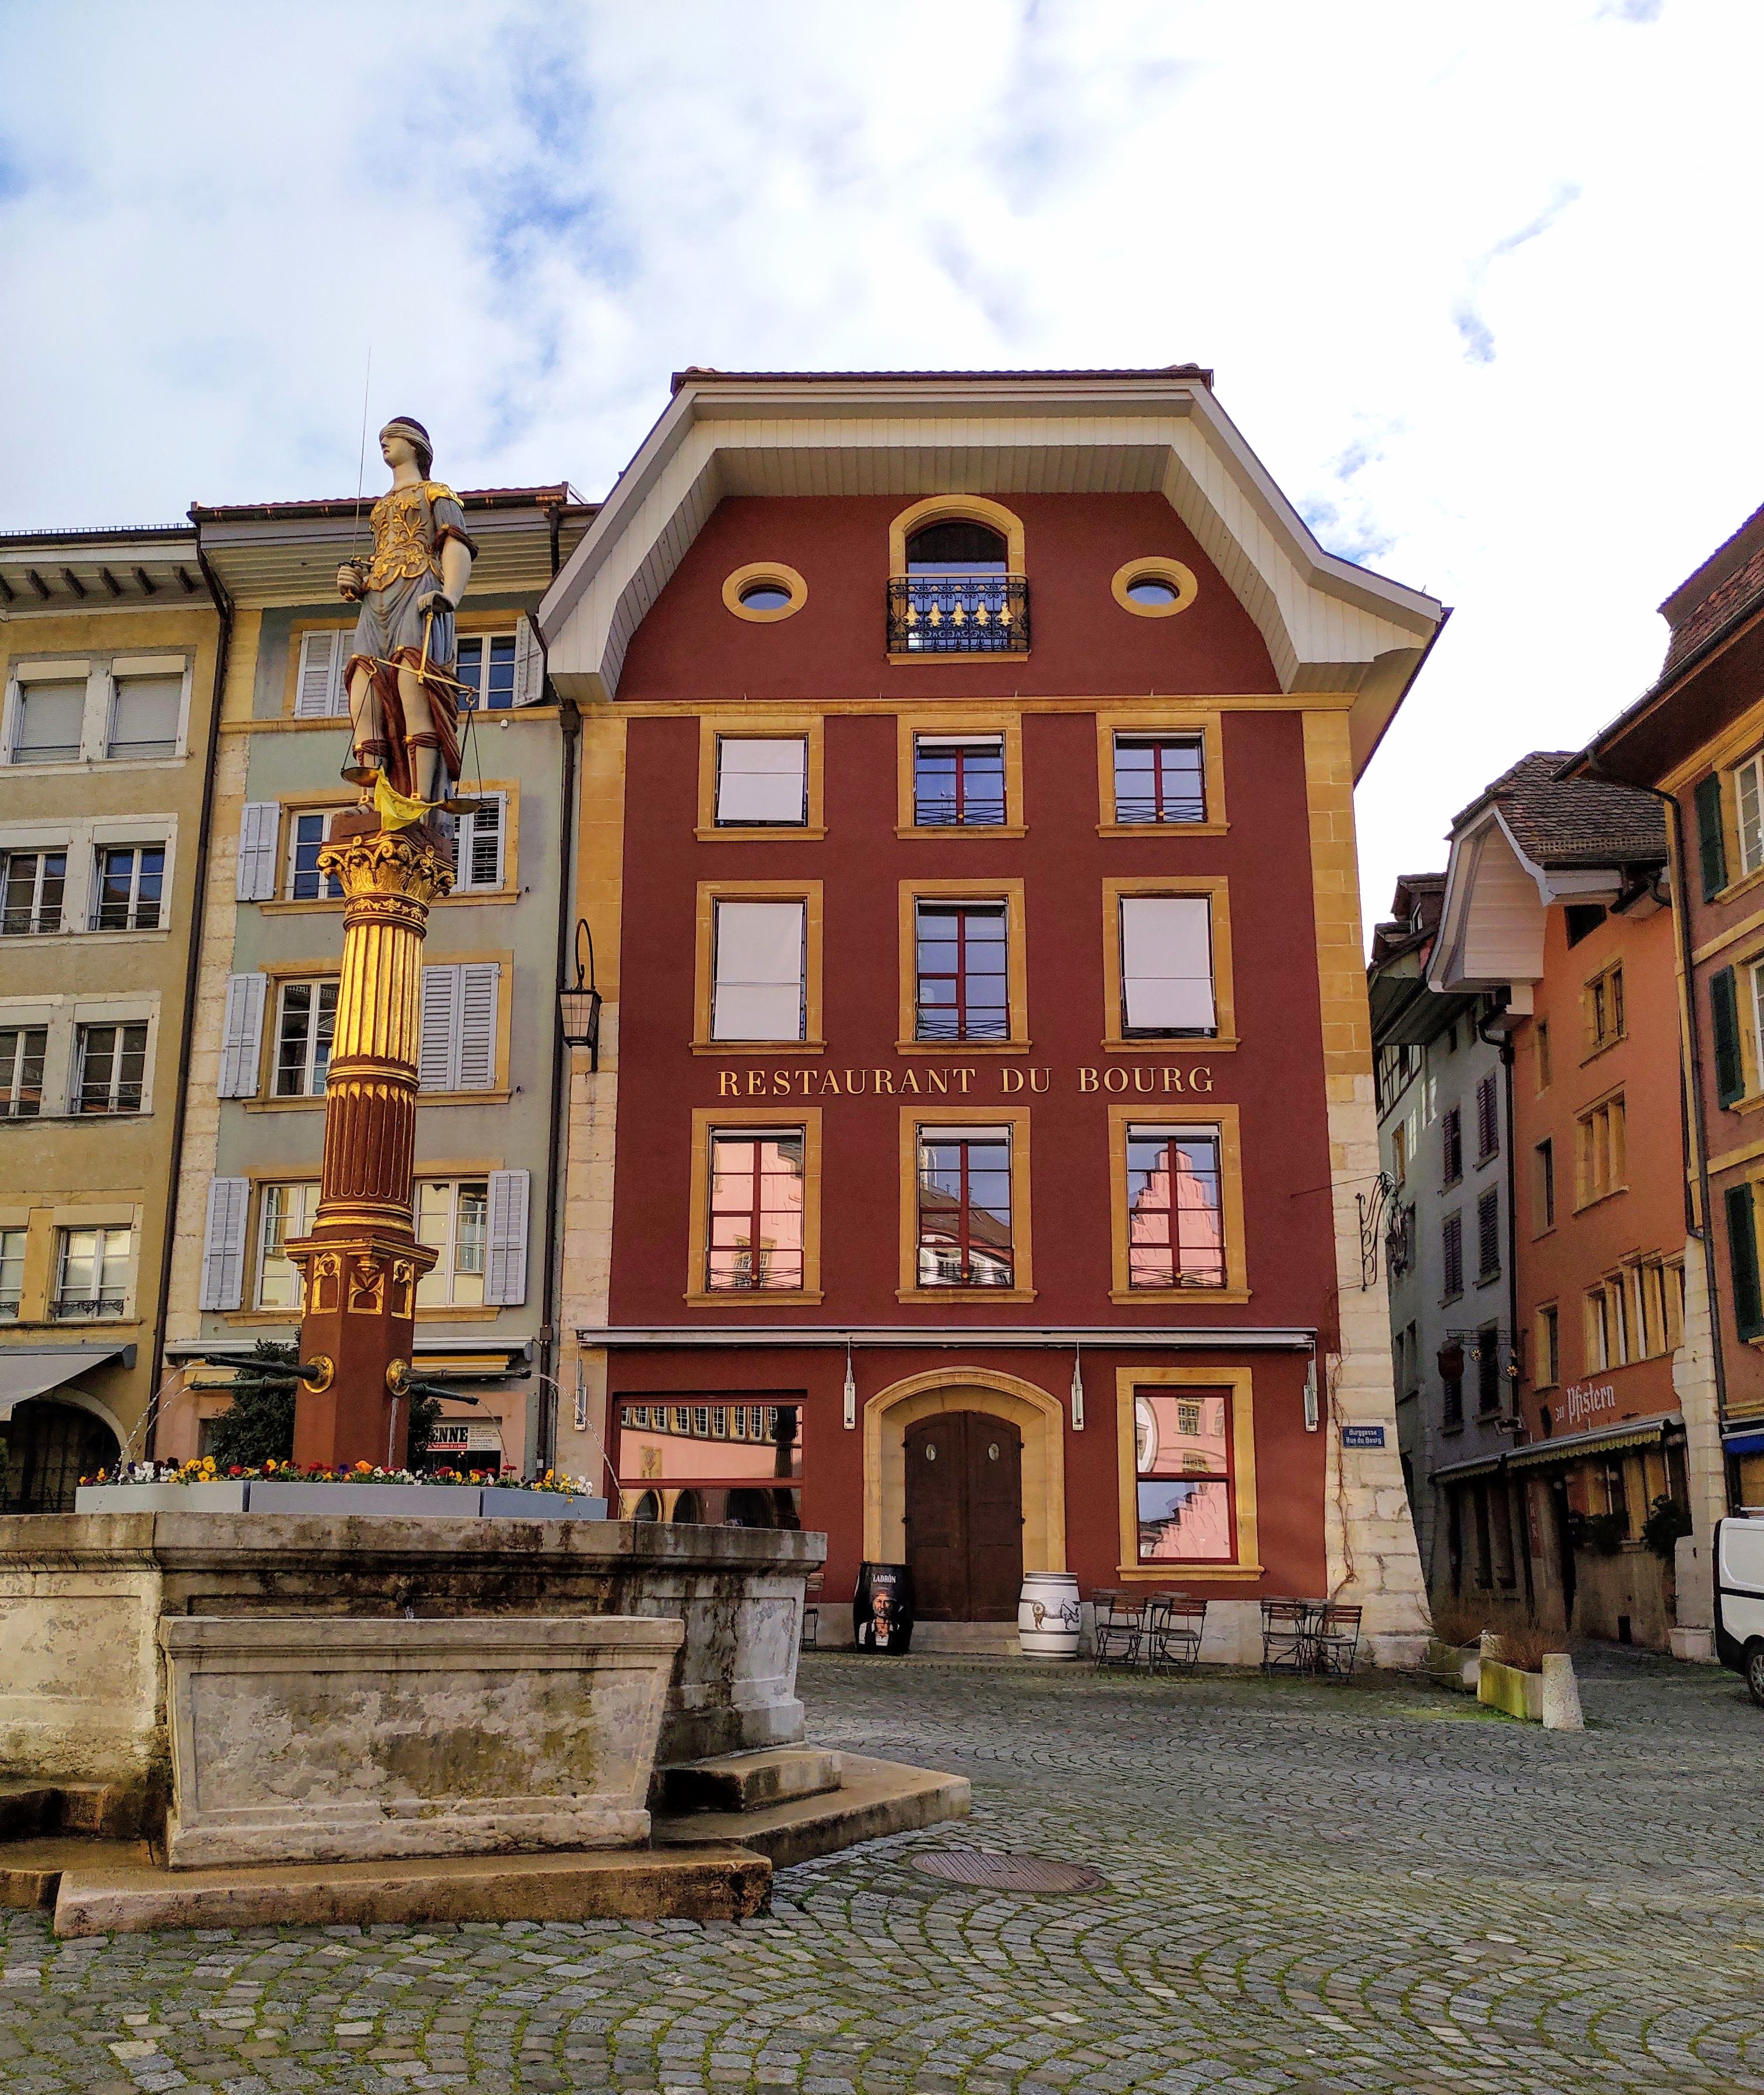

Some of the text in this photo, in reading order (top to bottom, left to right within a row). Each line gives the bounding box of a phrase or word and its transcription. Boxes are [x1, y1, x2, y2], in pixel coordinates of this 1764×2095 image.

[717, 1067, 1214, 1096] RESTAURANT DU BOURG
[1567, 1382, 1615, 1424] Pfistern
[432, 1427, 468, 1442] ENNE
